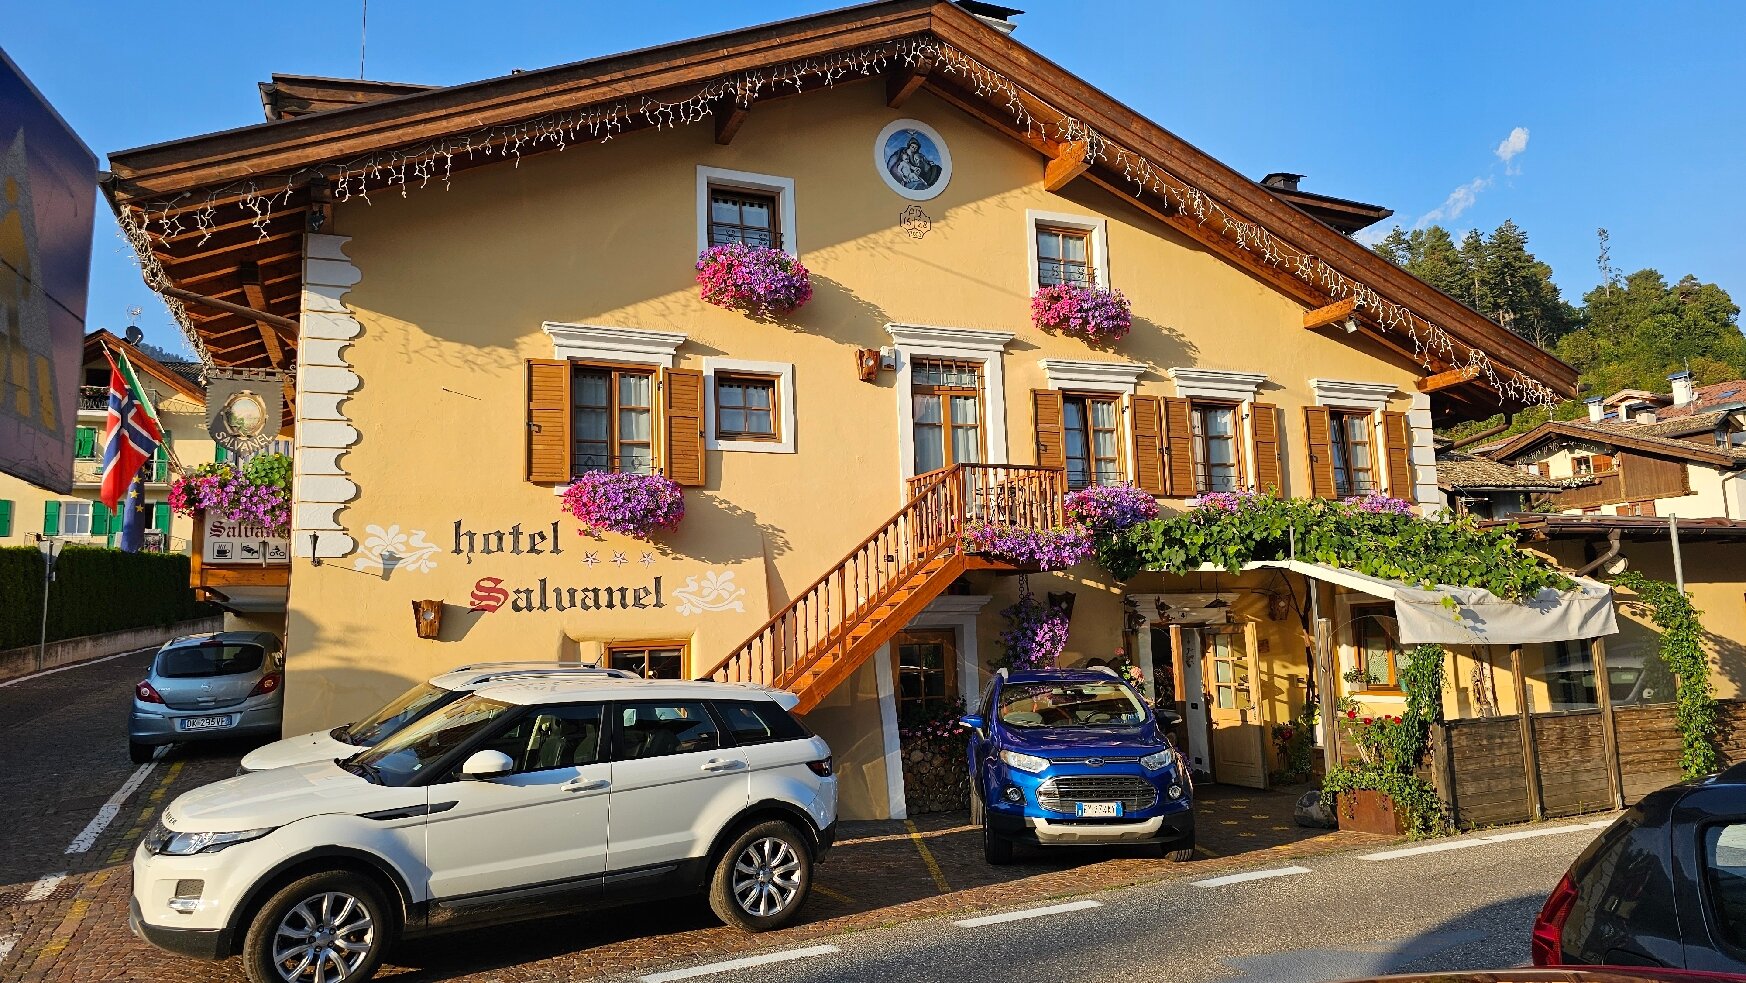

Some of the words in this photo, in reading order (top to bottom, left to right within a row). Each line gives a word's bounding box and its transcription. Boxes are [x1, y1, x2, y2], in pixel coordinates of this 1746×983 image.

[215, 431, 273, 451] SALVANEL
[210, 520, 290, 539] Salvan
[451, 519, 564, 564] hotel
[469, 576, 667, 613] Salvanel
